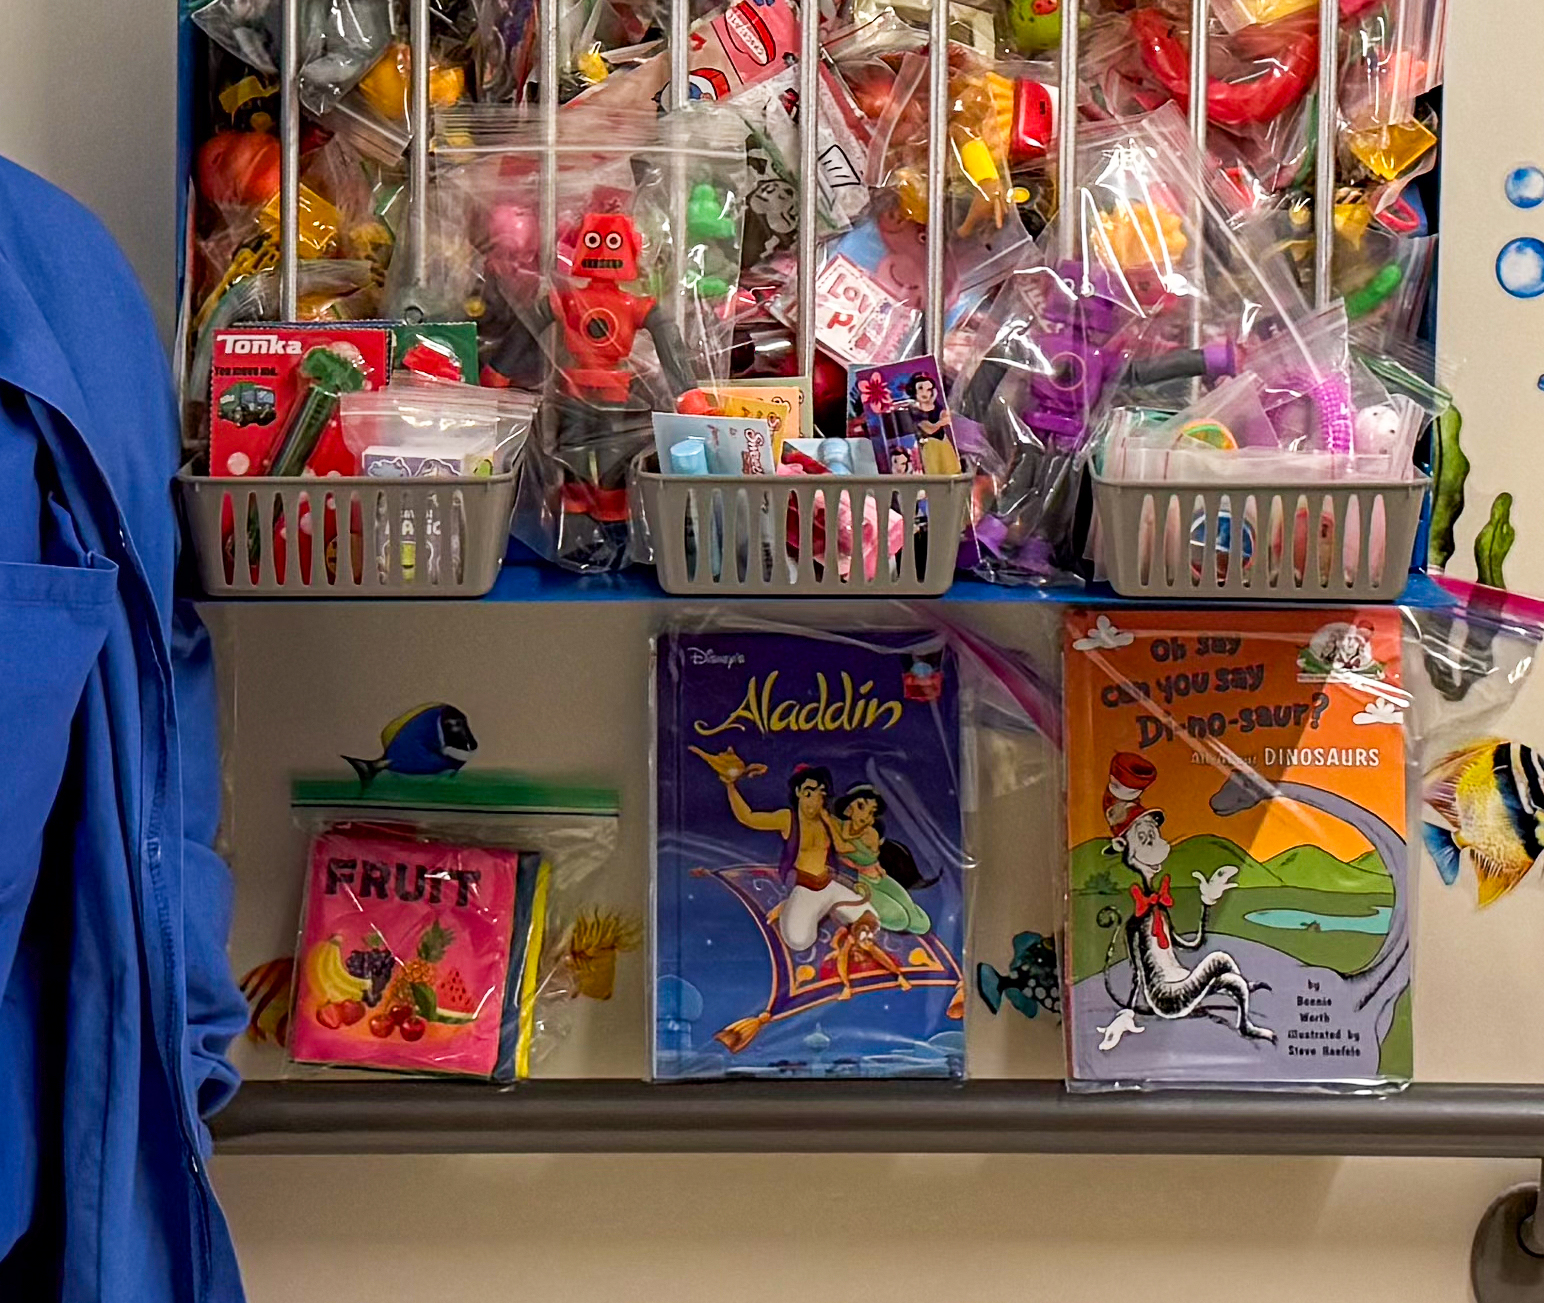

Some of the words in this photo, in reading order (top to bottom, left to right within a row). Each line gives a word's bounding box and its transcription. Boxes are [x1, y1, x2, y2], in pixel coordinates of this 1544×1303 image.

[217, 335, 302, 354] Tonka
[1150, 636, 1187, 662] Oh
[1196, 634, 1242, 657] say
[1158, 671, 1210, 704] you
[1215, 663, 1265, 693] say
[694, 669, 903, 739] Aladdin
[1264, 747, 1380, 767] DINOSAURS
[324, 857, 482, 908] FRUIT
